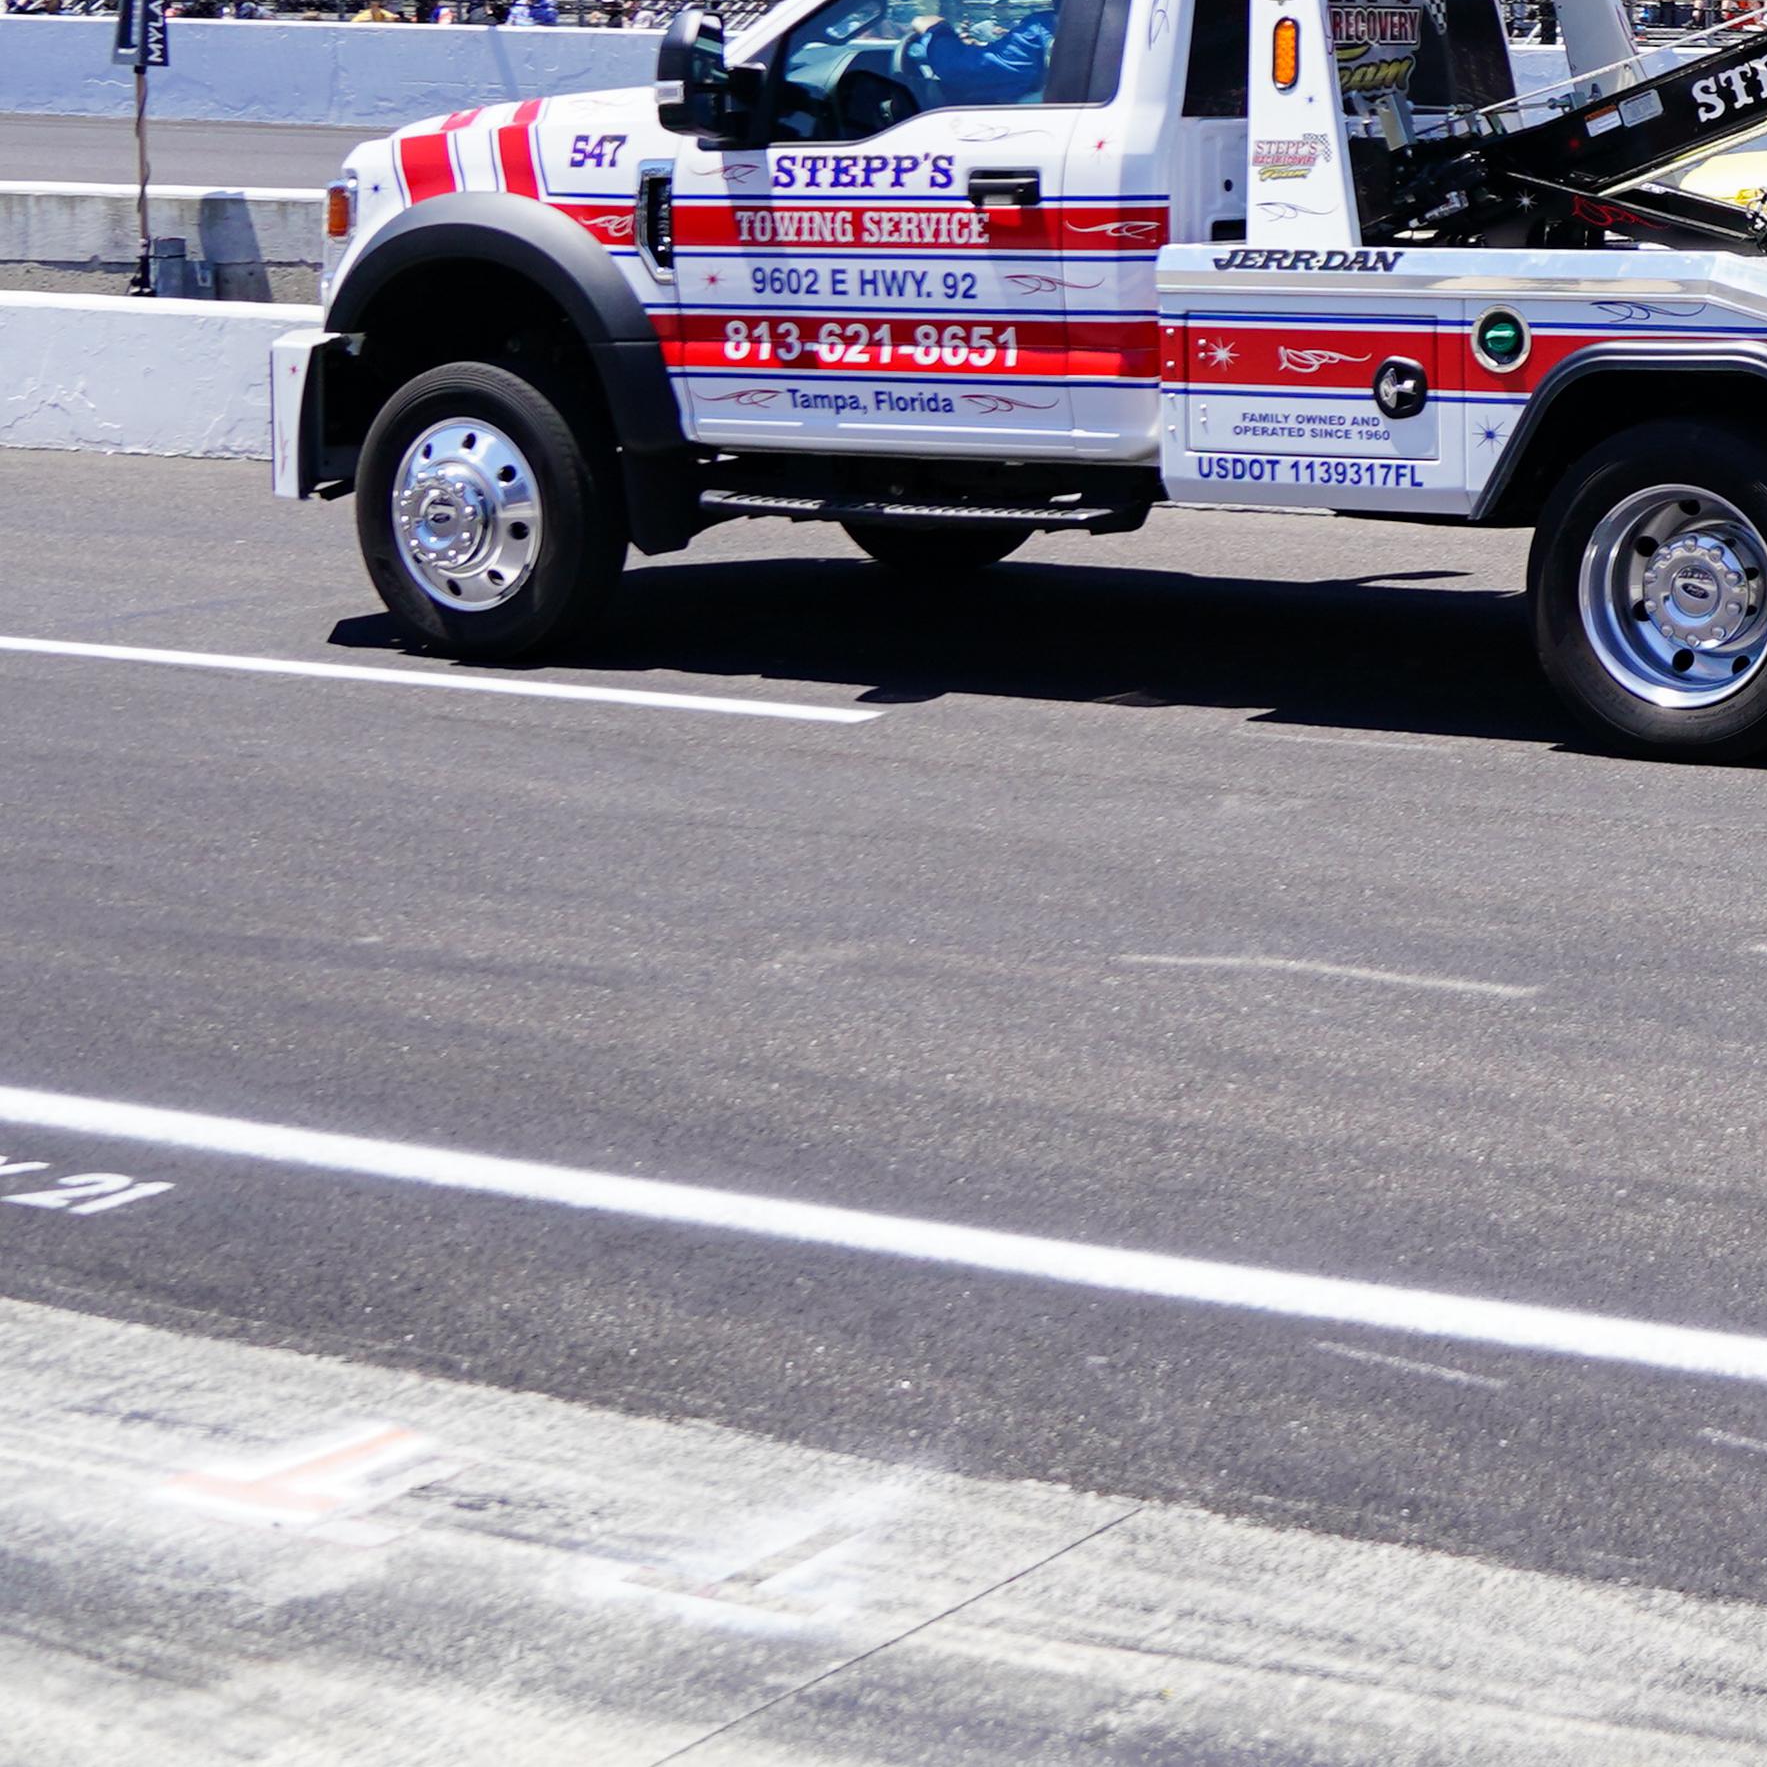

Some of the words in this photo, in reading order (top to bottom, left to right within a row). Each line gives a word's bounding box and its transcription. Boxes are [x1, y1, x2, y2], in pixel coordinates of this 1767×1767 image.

[1332, 8, 1419, 44] RECOVERY
[569, 134, 628, 168] 547
[771, 151, 955, 189] STEPP'S
[733, 210, 855, 243] TOWING
[861, 211, 991, 245] SERVICE
[751, 267, 820, 296] 9602
[831, 268, 847, 296] E
[859, 270, 933, 299] HWY.
[943, 272, 979, 300] 92
[723, 320, 1020, 368] 813-621-8651
[786, 388, 868, 415] Tampa,
[874, 390, 955, 414] Florida
[1232, 424, 1306, 439] OPERATED
[1310, 426, 1353, 440] SINCE
[1357, 429, 1391, 441] 1960
[1241, 412, 1291, 425] FAMILY
[1295, 413, 1347, 427] OWNED
[1351, 414, 1380, 428] AND
[1197, 456, 1281, 482] USDOT
[1290, 460, 1424, 488] 1139317FL
